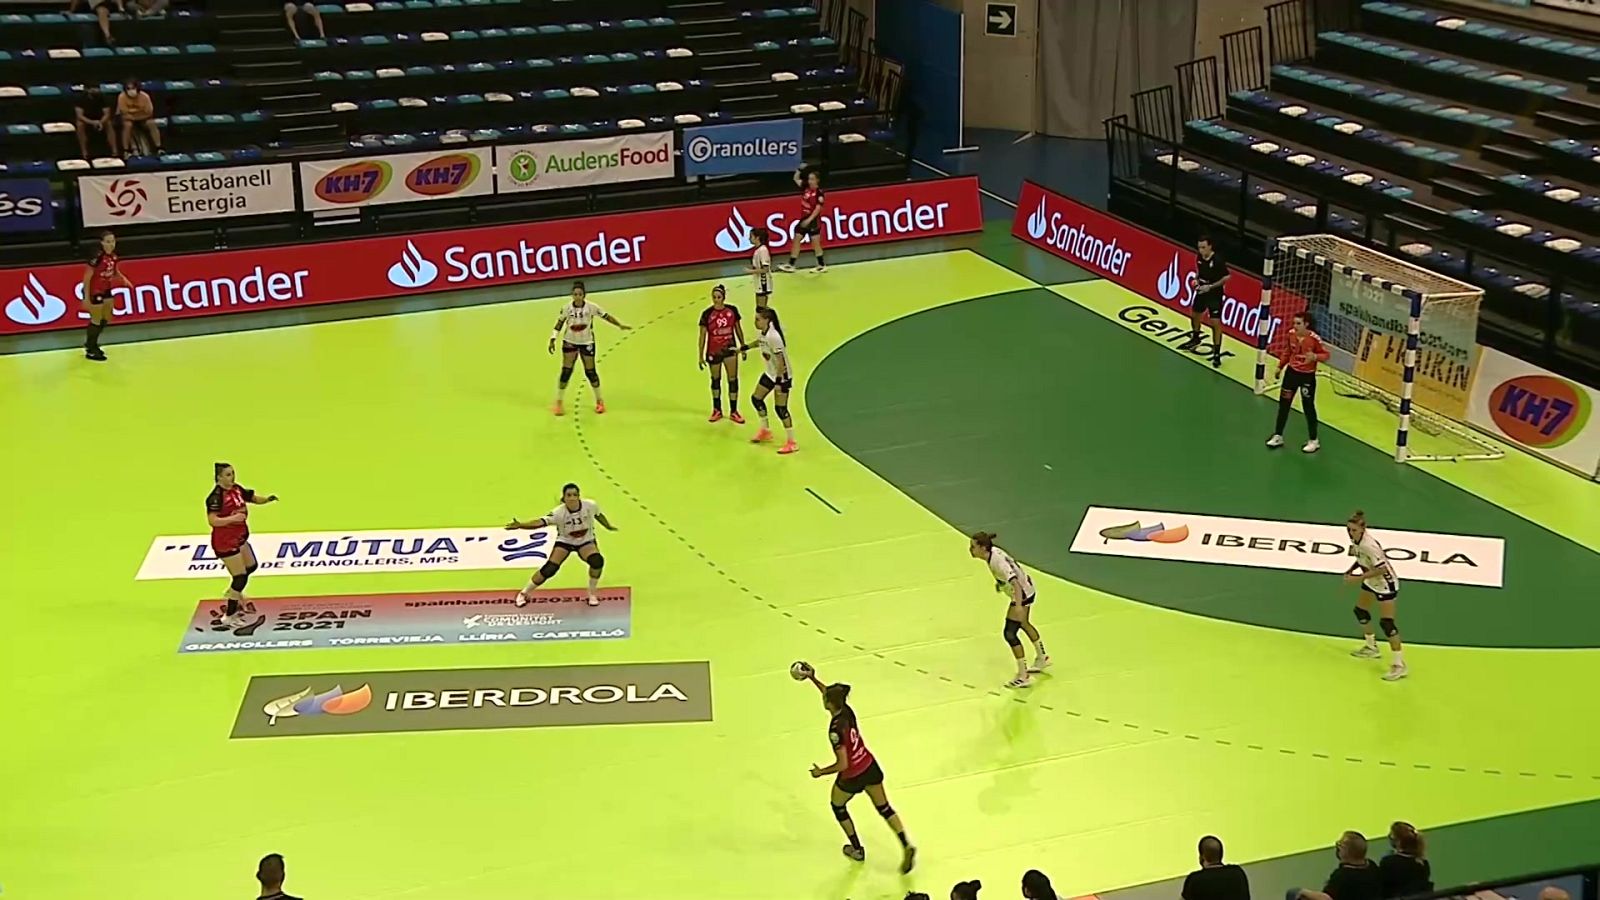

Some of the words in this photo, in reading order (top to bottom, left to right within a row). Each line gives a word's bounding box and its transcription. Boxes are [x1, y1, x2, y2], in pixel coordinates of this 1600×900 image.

[544, 143, 670, 174] AudensFood
[688, 136, 798, 163] Granollers
[165, 169, 272, 193] Estabanell
[168, 193, 247, 214] Energia
[445, 232, 646, 282] Santander
[1046, 212, 1132, 277] Santander
[1179, 270, 1282, 344] Sandr
[260, 561, 285, 569] DE
[420, 555, 459, 564] MPS
[1201, 533, 1479, 568] IBERDOLA
[272, 620, 345, 632] 2021
[277, 609, 372, 621] SPAIN
[185, 638, 313, 651] GRANOLLERS
[328, 633, 445, 645] TORREVIEJA
[458, 631, 518, 641] LLÍRIA
[532, 628, 625, 639] CASTELLÓ
[385, 683, 689, 711] IBERDROLA
